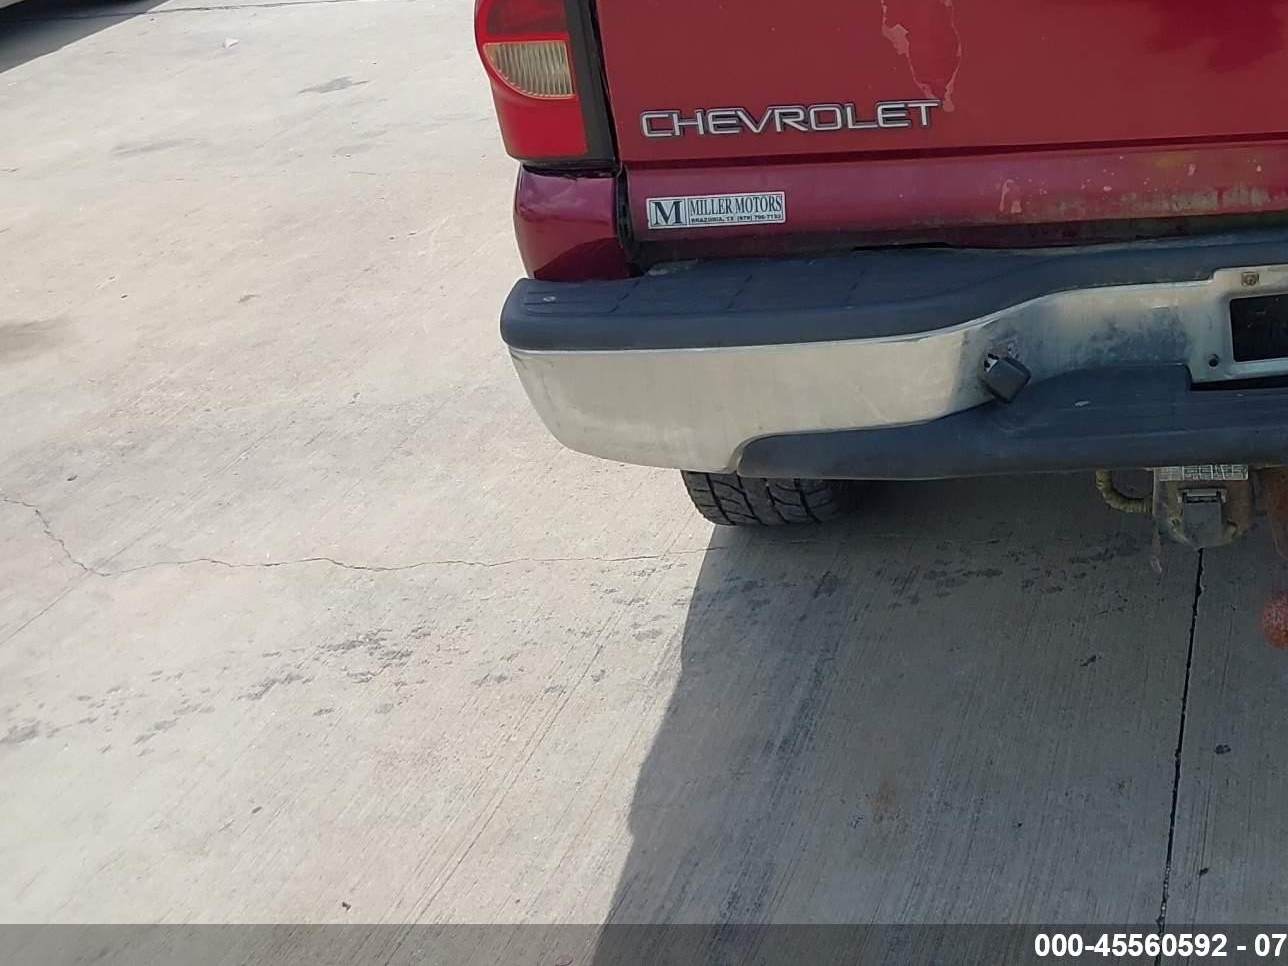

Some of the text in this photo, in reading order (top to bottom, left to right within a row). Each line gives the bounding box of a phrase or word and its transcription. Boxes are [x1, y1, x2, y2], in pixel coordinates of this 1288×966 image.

[641, 99, 941, 137] CHEVROLET
[652, 201, 682, 225] M
[690, 196, 782, 216] MILLER MOTORS
